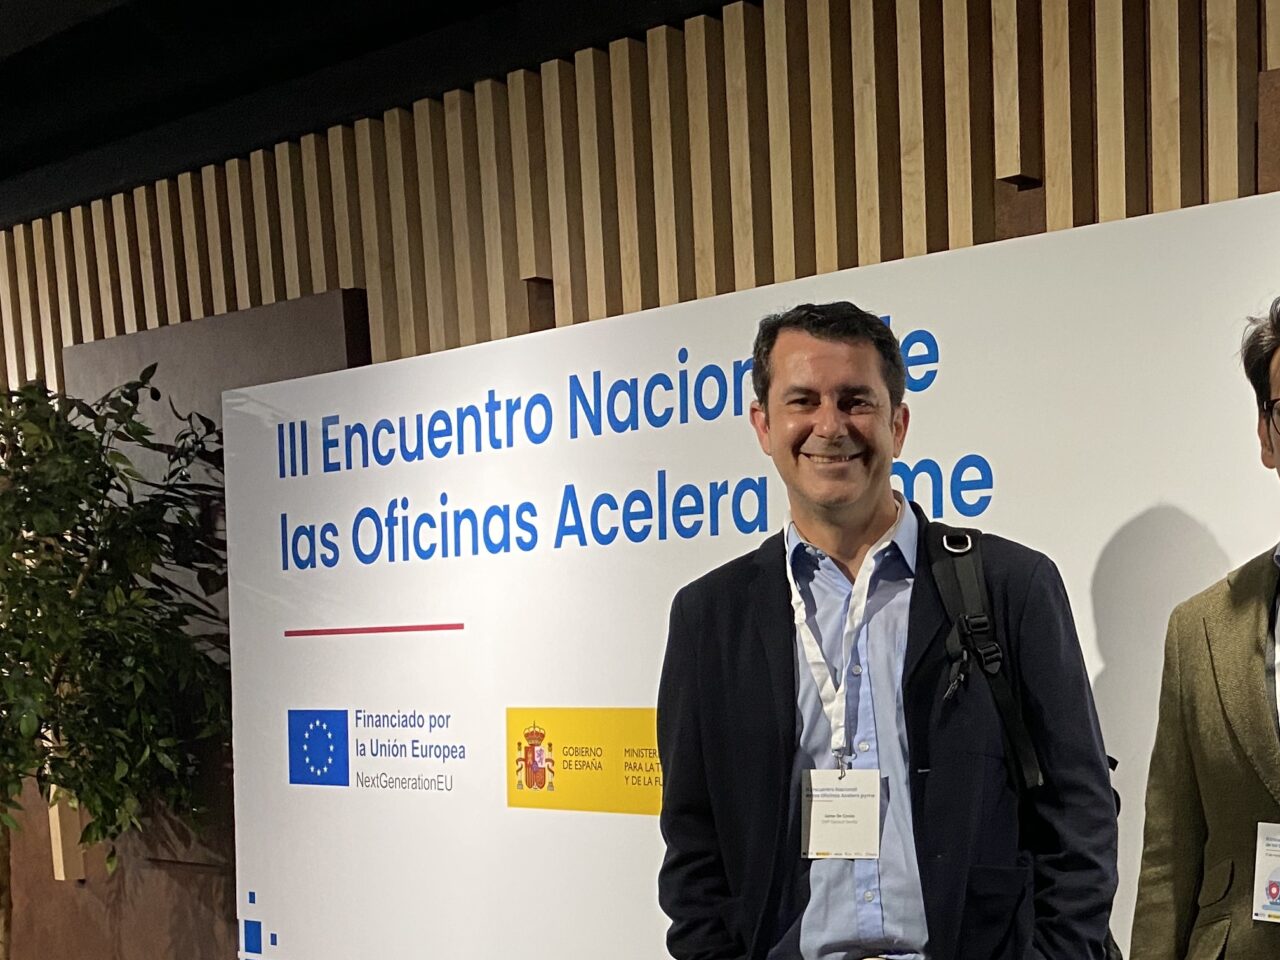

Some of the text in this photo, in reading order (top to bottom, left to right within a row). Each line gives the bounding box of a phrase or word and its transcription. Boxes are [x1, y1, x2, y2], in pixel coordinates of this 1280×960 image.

[277, 419, 309, 479] III
[321, 389, 552, 473] Encuentro
[880, 315, 940, 393] e
[280, 512, 340, 571] las
[352, 492, 538, 565] Oficinas
[553, 469, 768, 549] Acelera
[355, 709, 451, 733] Financiado por
[355, 738, 466, 764] la Unión Europea
[562, 746, 603, 758] GOBIERNO
[562, 758, 603, 771] DE ESPAÑA
[624, 761, 644, 772] PARA
[645, 762, 655, 773] LA
[356, 771, 453, 792] NextGenerationEU
[624, 775, 630, 785] Y
[631, 775, 642, 786] DE
[643, 776, 653, 787] LA
